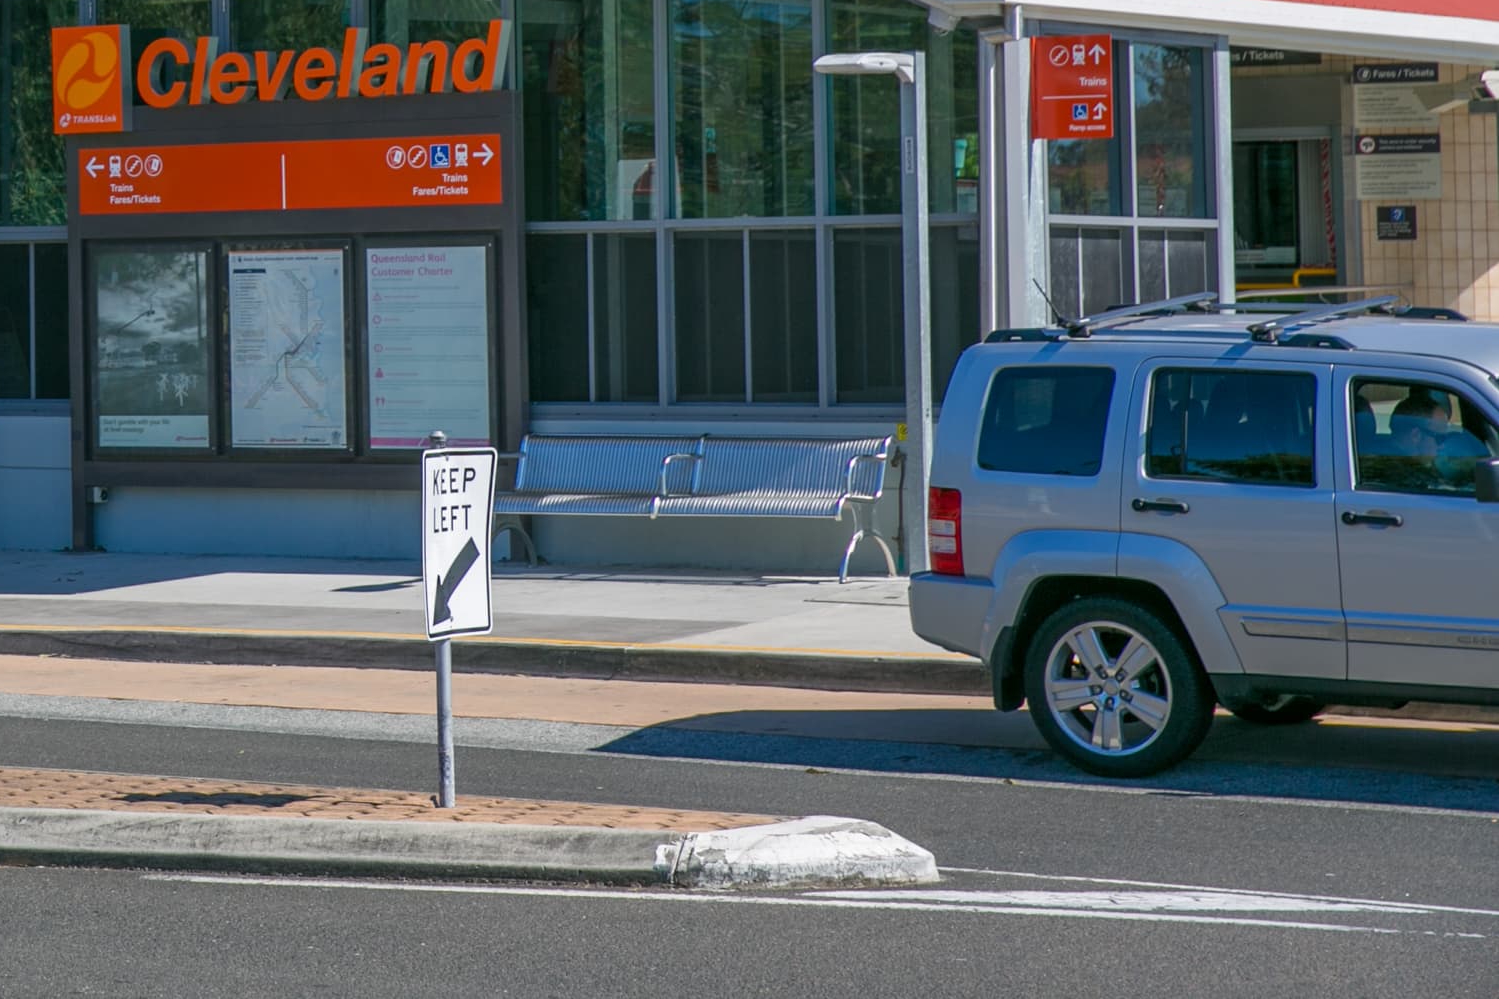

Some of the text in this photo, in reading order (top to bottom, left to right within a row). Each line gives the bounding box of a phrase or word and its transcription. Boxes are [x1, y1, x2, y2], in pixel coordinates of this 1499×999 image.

[1249, 50, 1285, 61] Tickets
[137, 19, 505, 109] Cleveland
[1372, 69, 1396, 79] Fares
[1403, 67, 1435, 78] Tickets
[1079, 76, 1108, 87] Trains
[442, 173, 468, 183] Trains
[110, 183, 135, 193] Trains
[412, 185, 469, 197] Fares/Tickets
[110, 195, 162, 205] Fares/Tickets
[371, 252, 446, 264] Queensland Rail
[371, 266, 453, 276] Customer Charter
[433, 467, 476, 496] KEEP
[433, 504, 472, 533] LEFT
